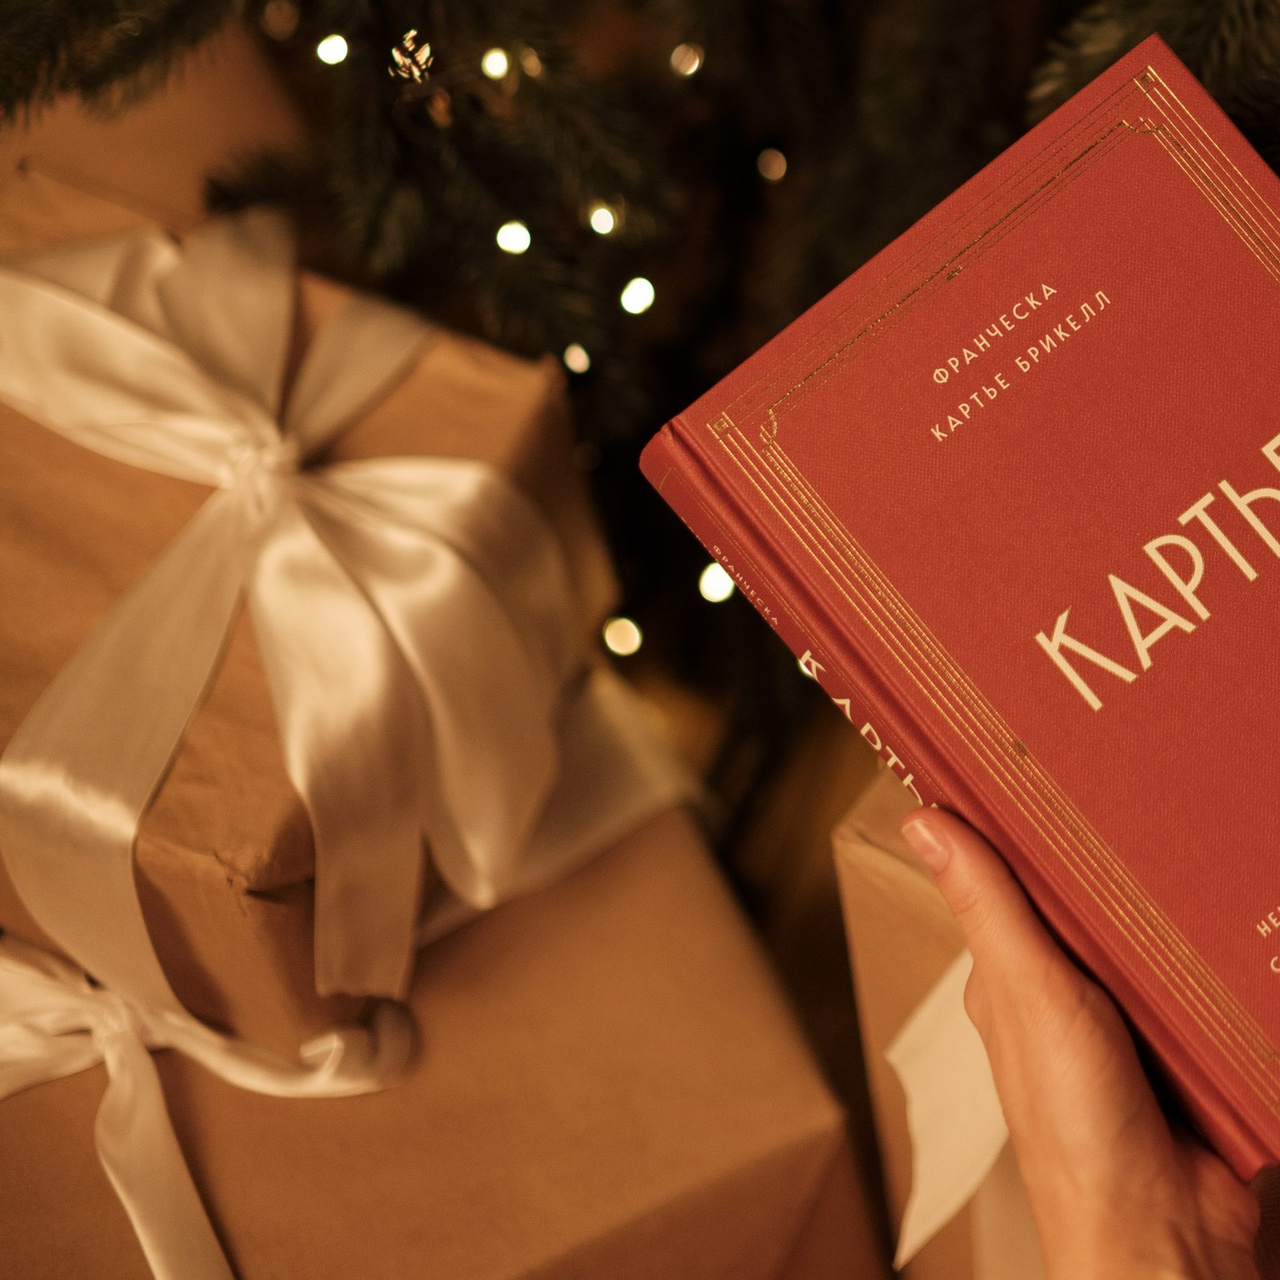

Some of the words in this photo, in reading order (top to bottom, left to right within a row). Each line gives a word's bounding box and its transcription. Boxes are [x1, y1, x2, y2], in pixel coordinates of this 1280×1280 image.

[930, 372, 1010, 442] КАРТЬЕ
[1014, 290, 1111, 373] БРИКЕЛЛ
[933, 283, 1057, 384] ФРАНЧЕСКА
[713, 545, 778, 625] ФРАНЧЕСКА
